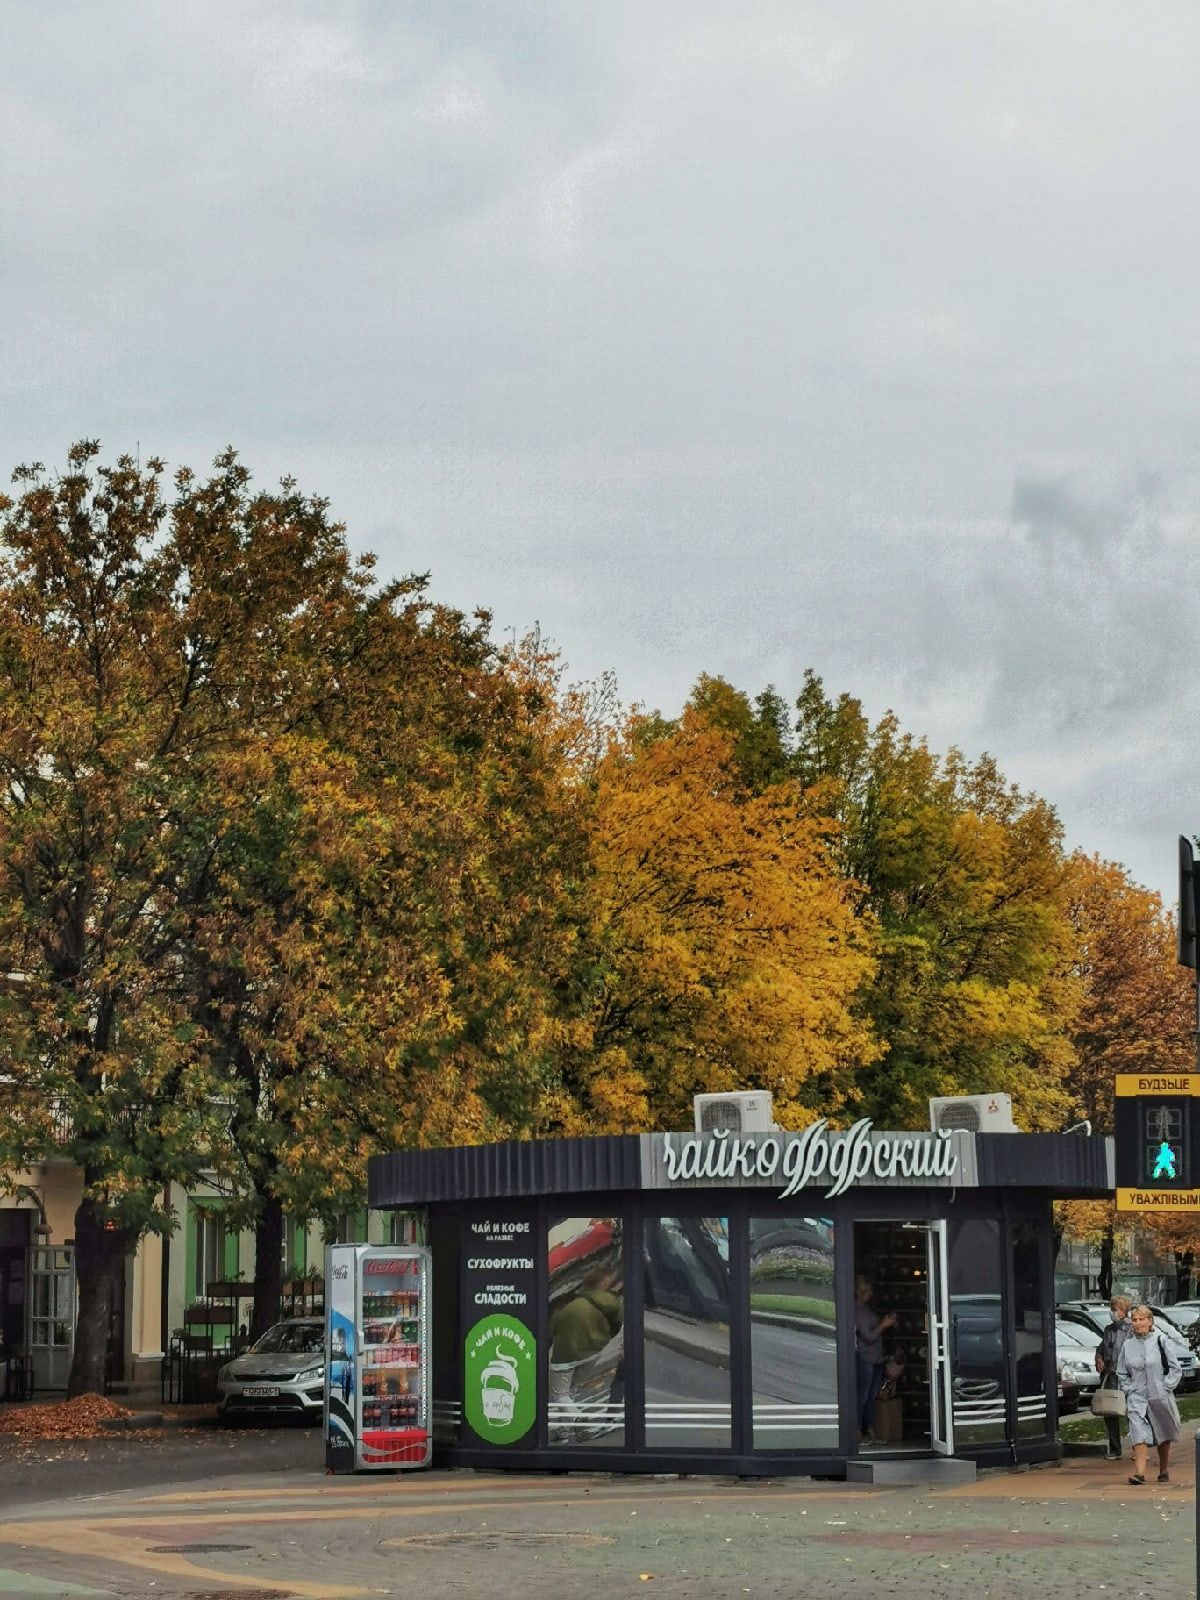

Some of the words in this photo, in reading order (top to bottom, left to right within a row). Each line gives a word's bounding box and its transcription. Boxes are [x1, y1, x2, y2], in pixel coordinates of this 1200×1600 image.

[1138, 1078, 1190, 1092] БУДЗЬЦЕ
[1129, 1193, 1200, 1205] УВАЖЛІВЫМ
[471, 1220, 491, 1233] ЧАЙ
[493, 1223, 500, 1232] И
[501, 1222, 530, 1233] КОФЕ
[467, 1258, 534, 1269] СУХОФРУКТЫ
[474, 1293, 527, 1305] СЛАДОСТИ
[502, 1327, 525, 1350] КОФЕ
